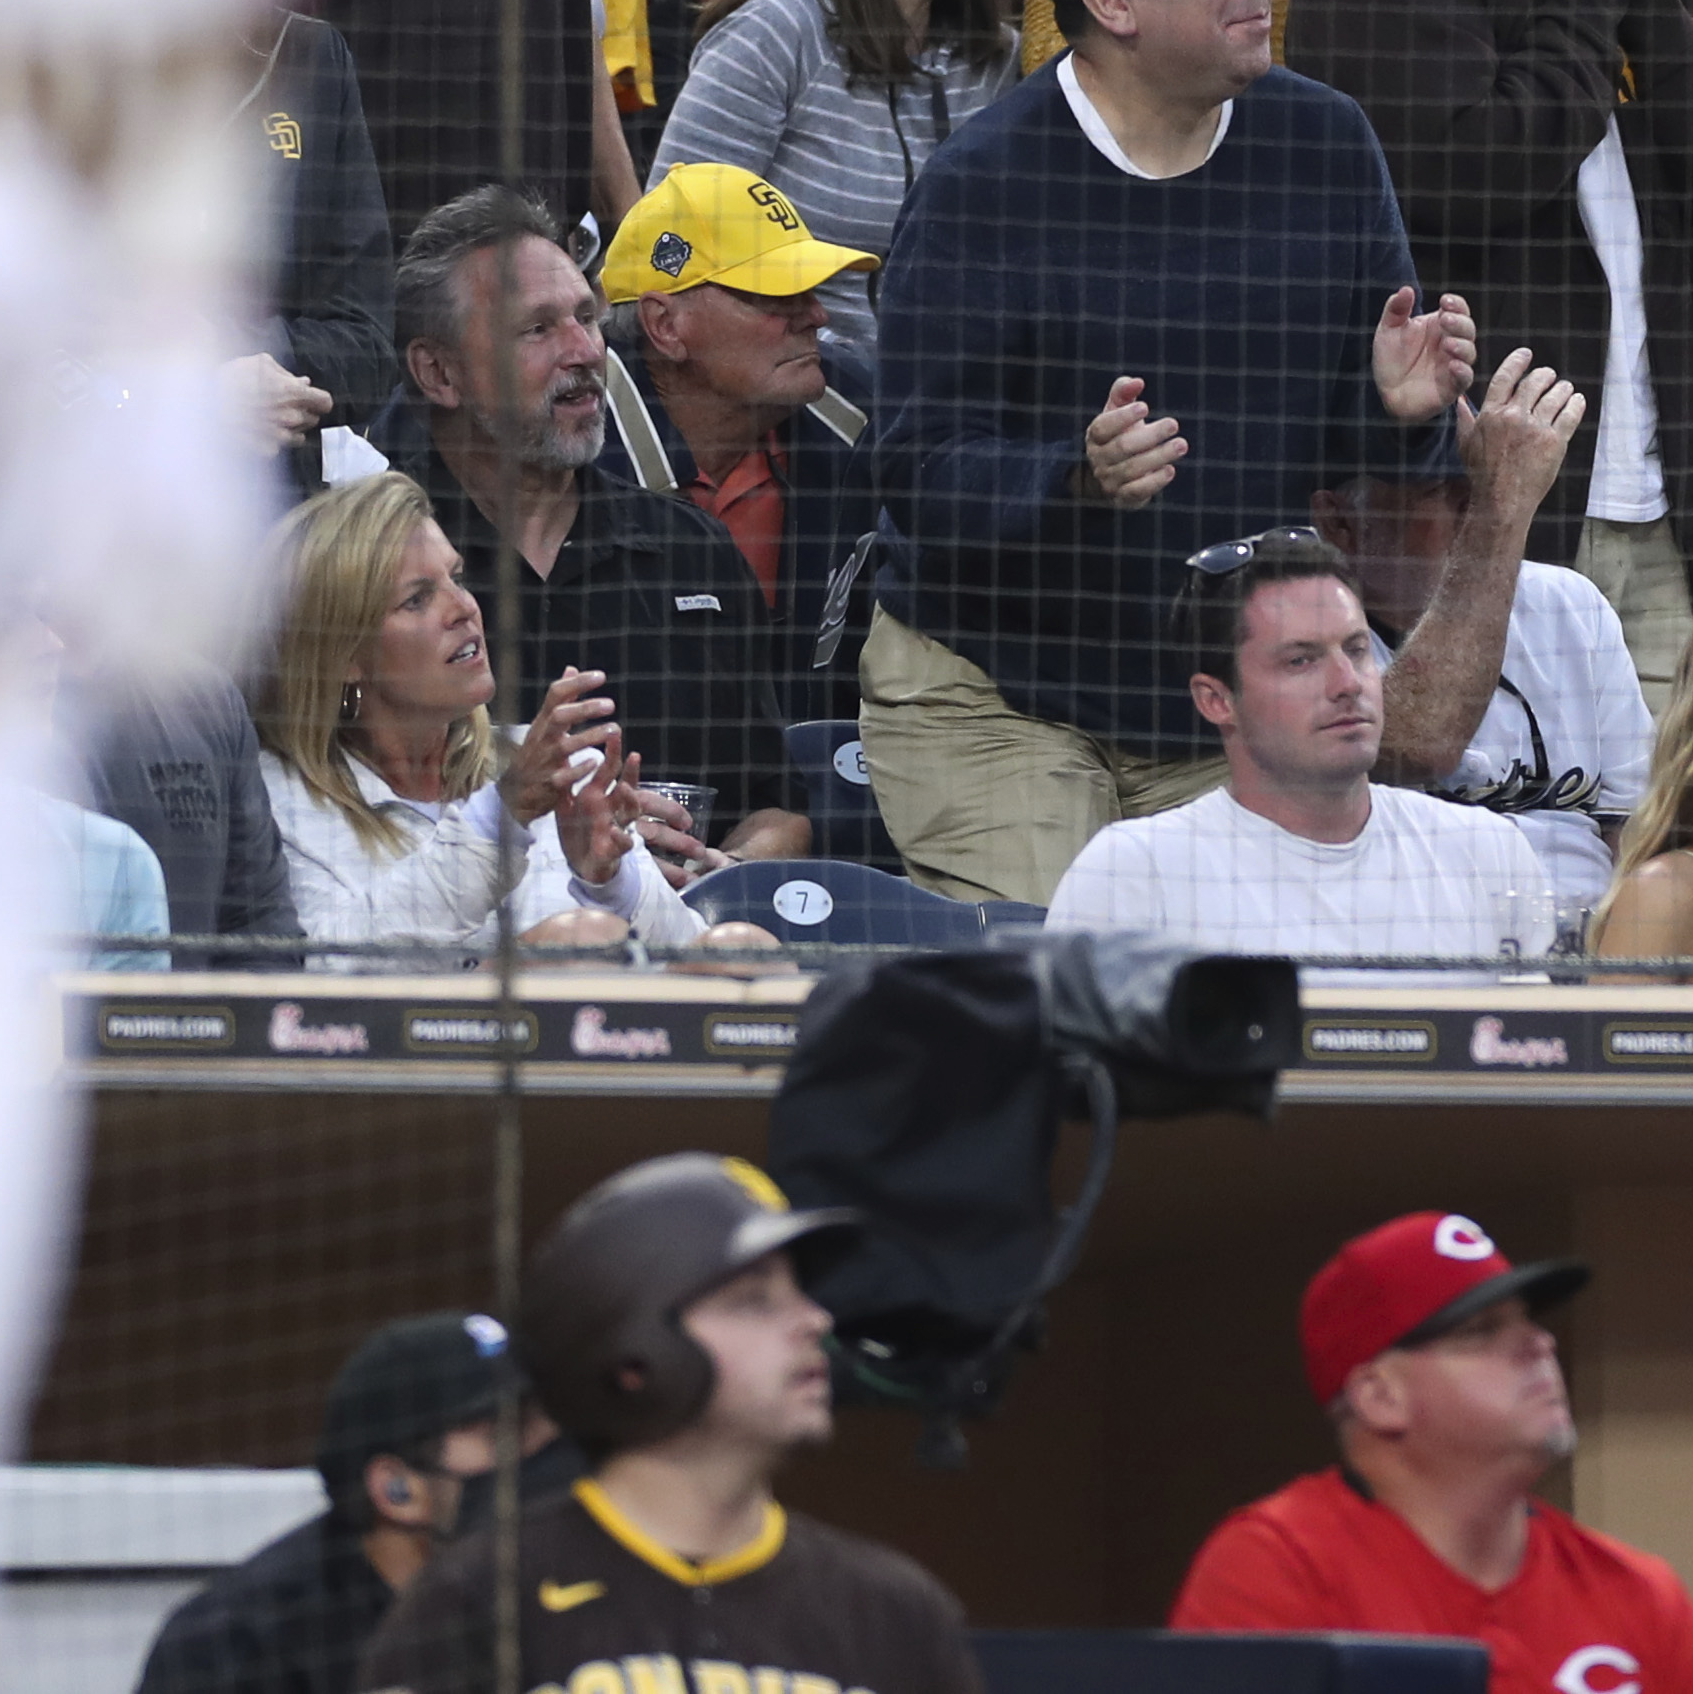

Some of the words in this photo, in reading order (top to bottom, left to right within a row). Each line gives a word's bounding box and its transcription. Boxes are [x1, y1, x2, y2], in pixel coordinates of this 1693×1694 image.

[263, 111, 302, 160] SD
[747, 181, 799, 232] SD
[795, 891, 809, 915] 7
[409, 1019, 529, 1042] PADRES.CM
[1311, 1029, 1429, 1052] PADRES.COM
[1433, 1213, 1495, 1262] C
